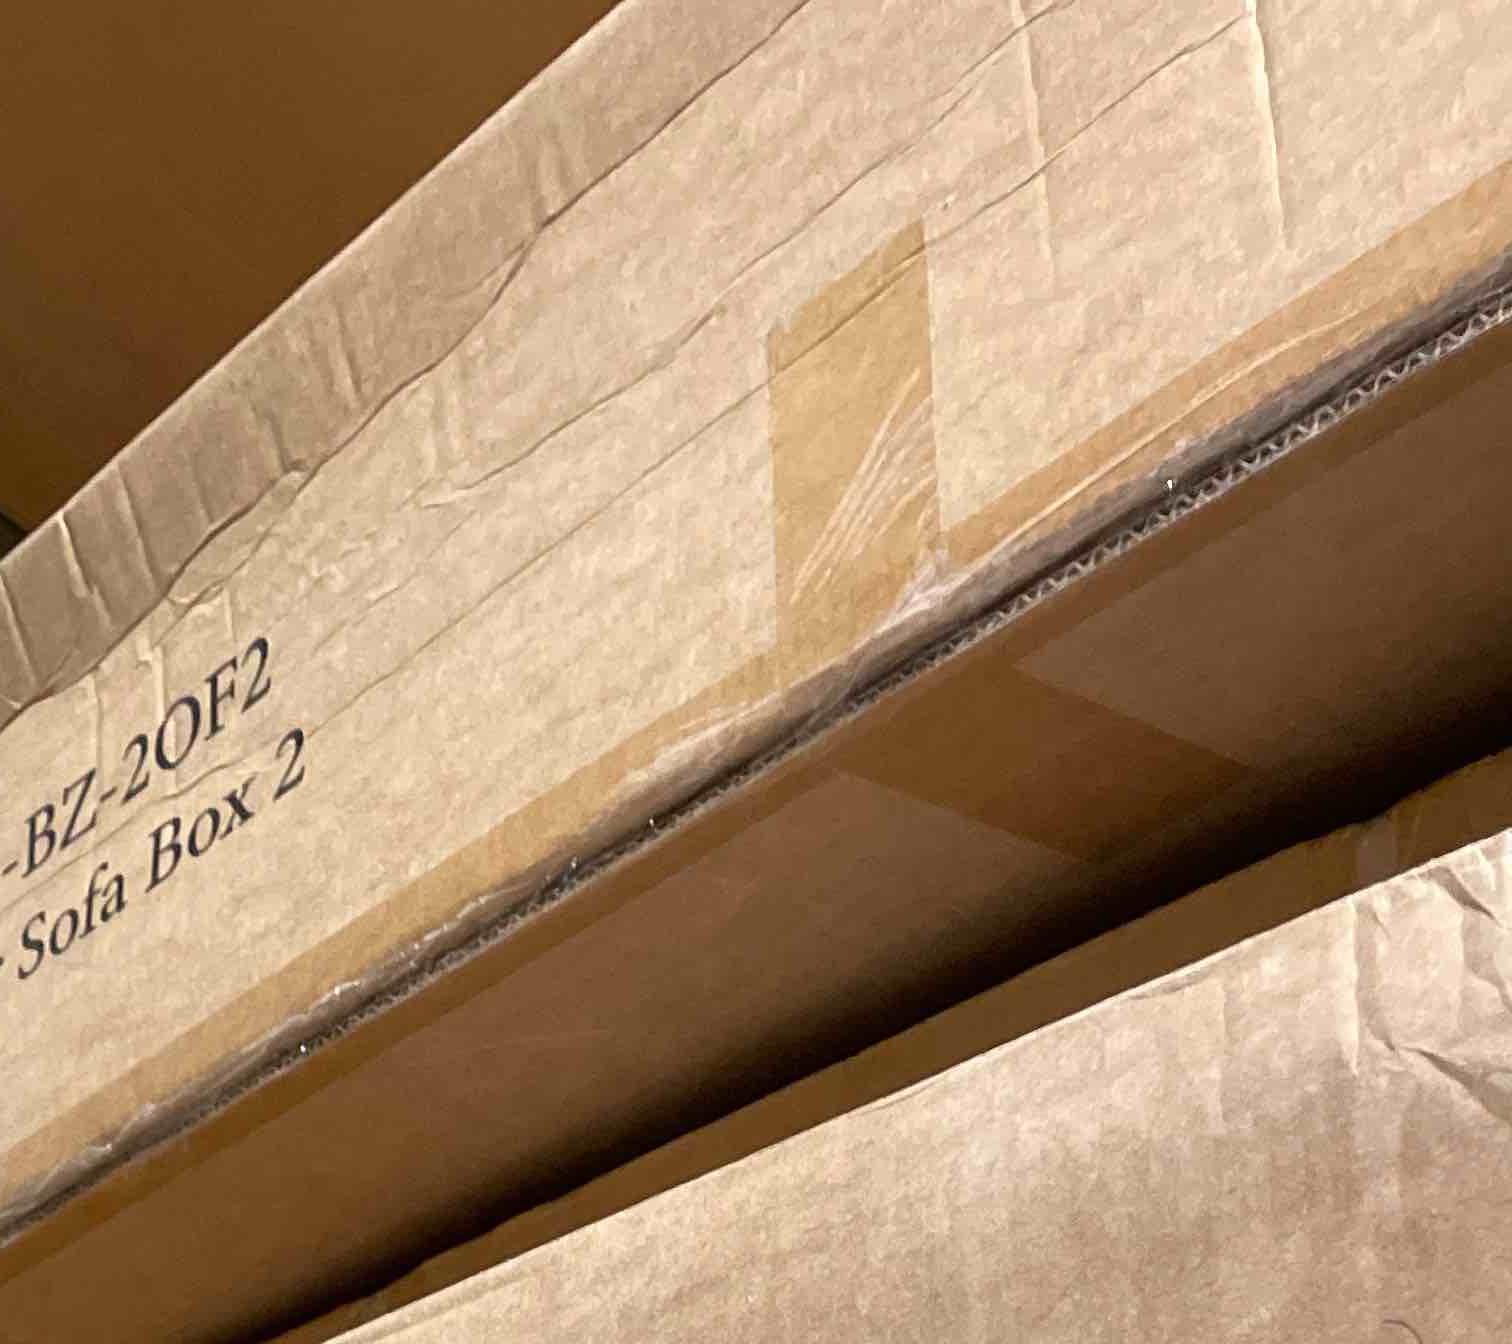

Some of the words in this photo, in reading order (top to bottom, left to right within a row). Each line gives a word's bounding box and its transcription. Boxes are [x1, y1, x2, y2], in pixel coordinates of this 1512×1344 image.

[17, 862, 126, 980] Sofa
[144, 777, 256, 893] Box
[273, 727, 305, 801] 2
